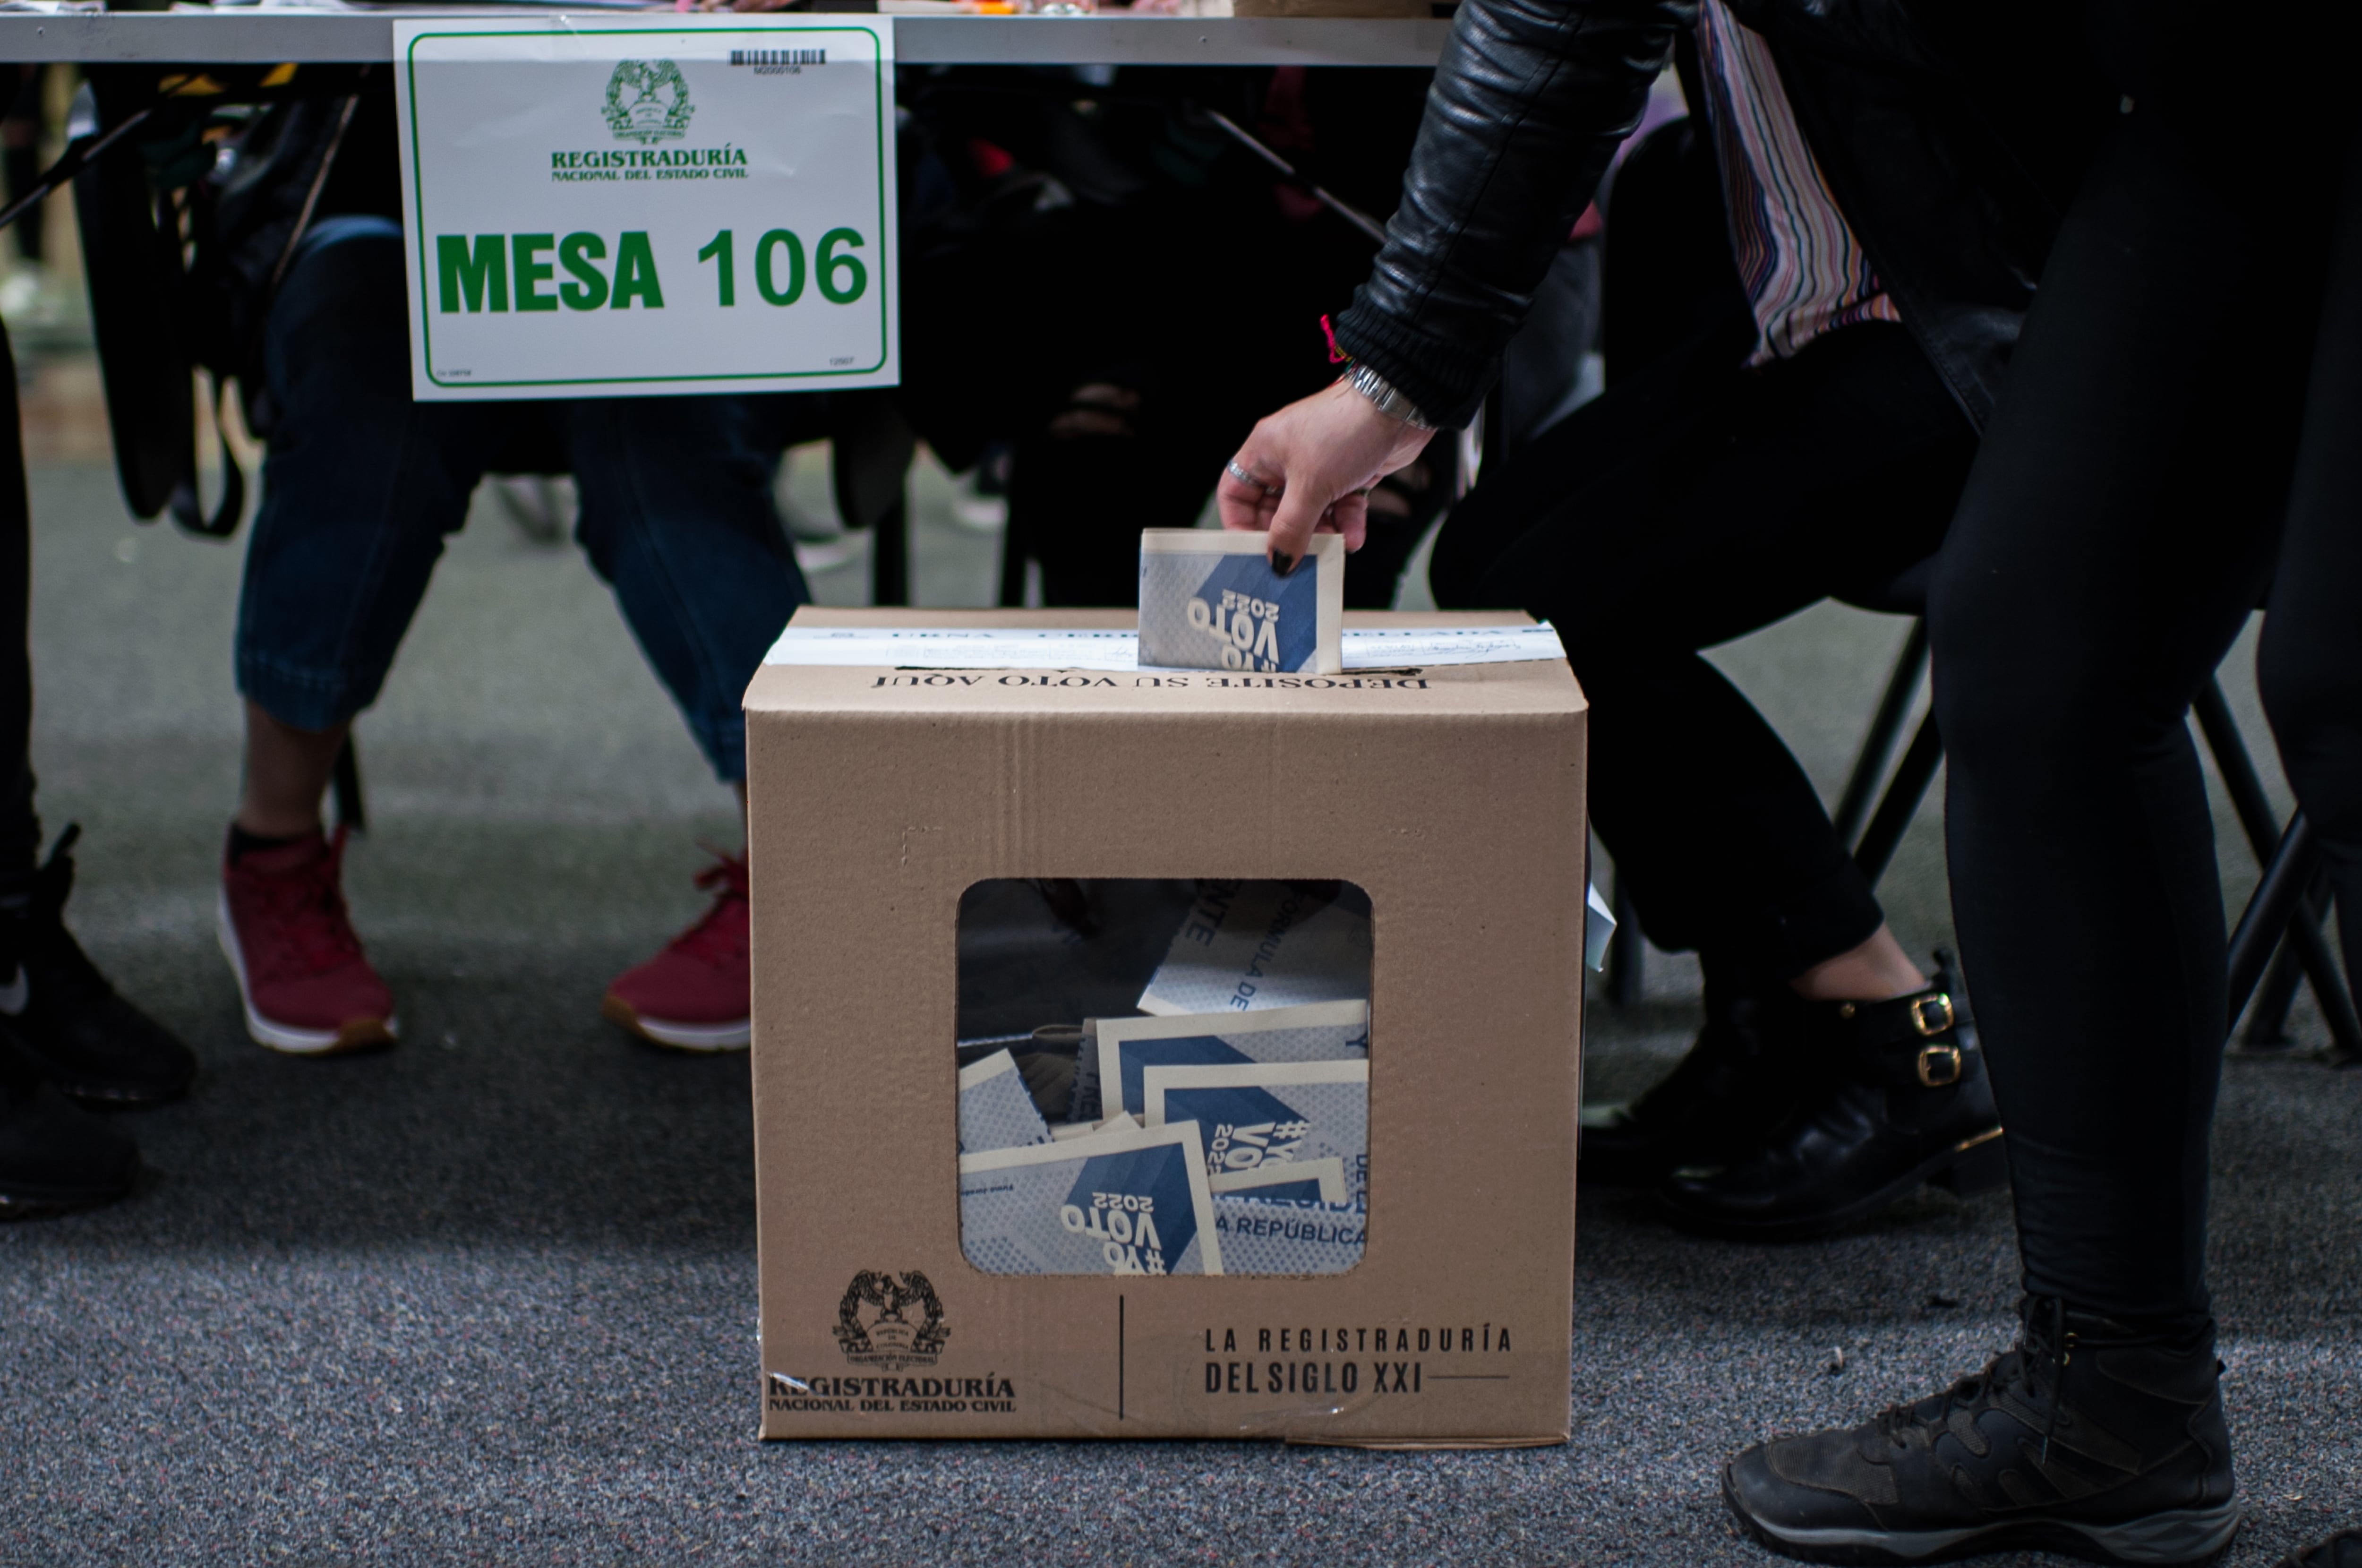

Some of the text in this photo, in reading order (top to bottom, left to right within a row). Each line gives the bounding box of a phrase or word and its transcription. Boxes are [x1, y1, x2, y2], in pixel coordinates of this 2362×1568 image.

[551, 143, 748, 169] REGISTRADURÍA
[552, 168, 749, 181] NACIONAL DEL ESTADO CIVIL
[436, 227, 867, 313] MESA 106
[1222, 589, 1279, 623] 2022
[1187, 597, 1279, 665] VOTO
[998, 675, 1118, 687] VOTO
[1135, 677, 1189, 688] SU
[1206, 677, 1432, 690] DEPOSITE
[1231, 982, 1256, 1011] DE
[1092, 1192, 1154, 1213] 2022
[1061, 1205, 1162, 1250] VOTO
[1236, 1217, 1366, 1245] REPÚBLICA
[1206, 1323, 1511, 1353] LA REGISTRADURÍA
[769, 1371, 1016, 1398] REGISTRADURÍA
[1206, 1362, 1421, 1393] DEL SIGLO XXI
[769, 1399, 1017, 1413] NACIONAL DEL ESTADO CIVIL
